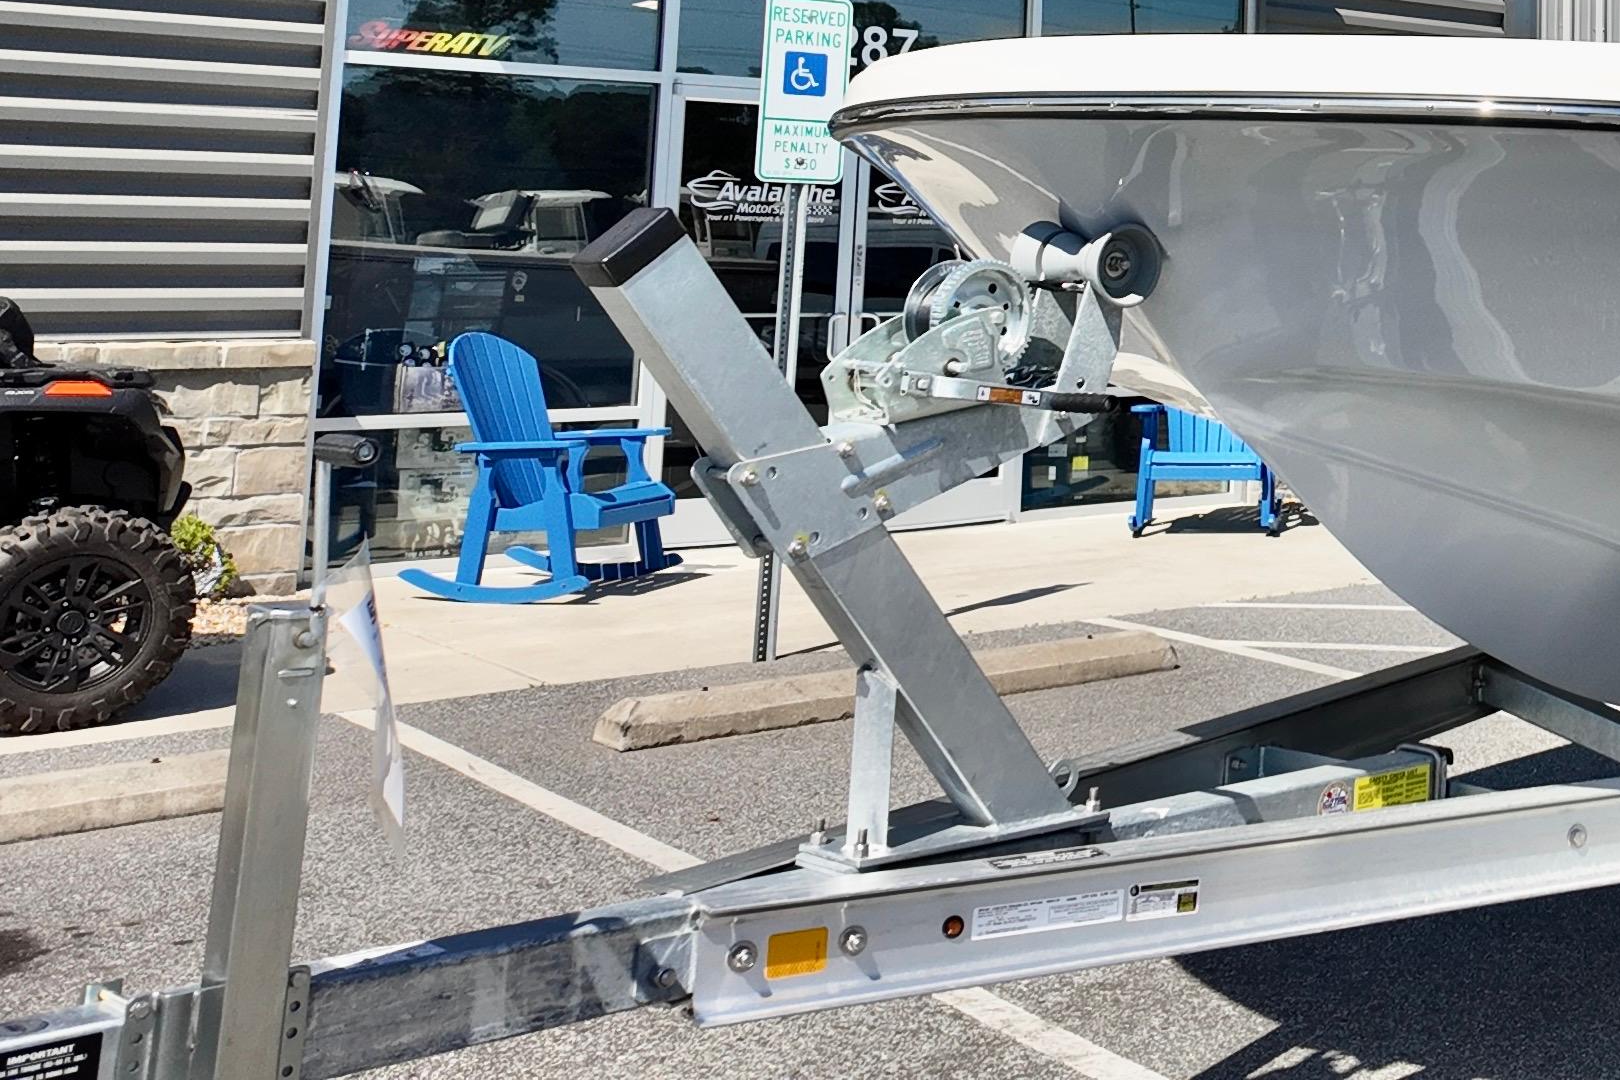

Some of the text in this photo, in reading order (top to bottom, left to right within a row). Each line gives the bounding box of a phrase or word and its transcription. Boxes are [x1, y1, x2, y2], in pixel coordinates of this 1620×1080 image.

[773, 6, 846, 27] RESERVED
[775, 28, 842, 49] PARKING
[774, 124, 831, 138] MAXIMUM
[774, 140, 829, 155] PENALTY
[716, 182, 836, 204] Avalahe
[6, 1043, 76, 1066] IMPORTANT
